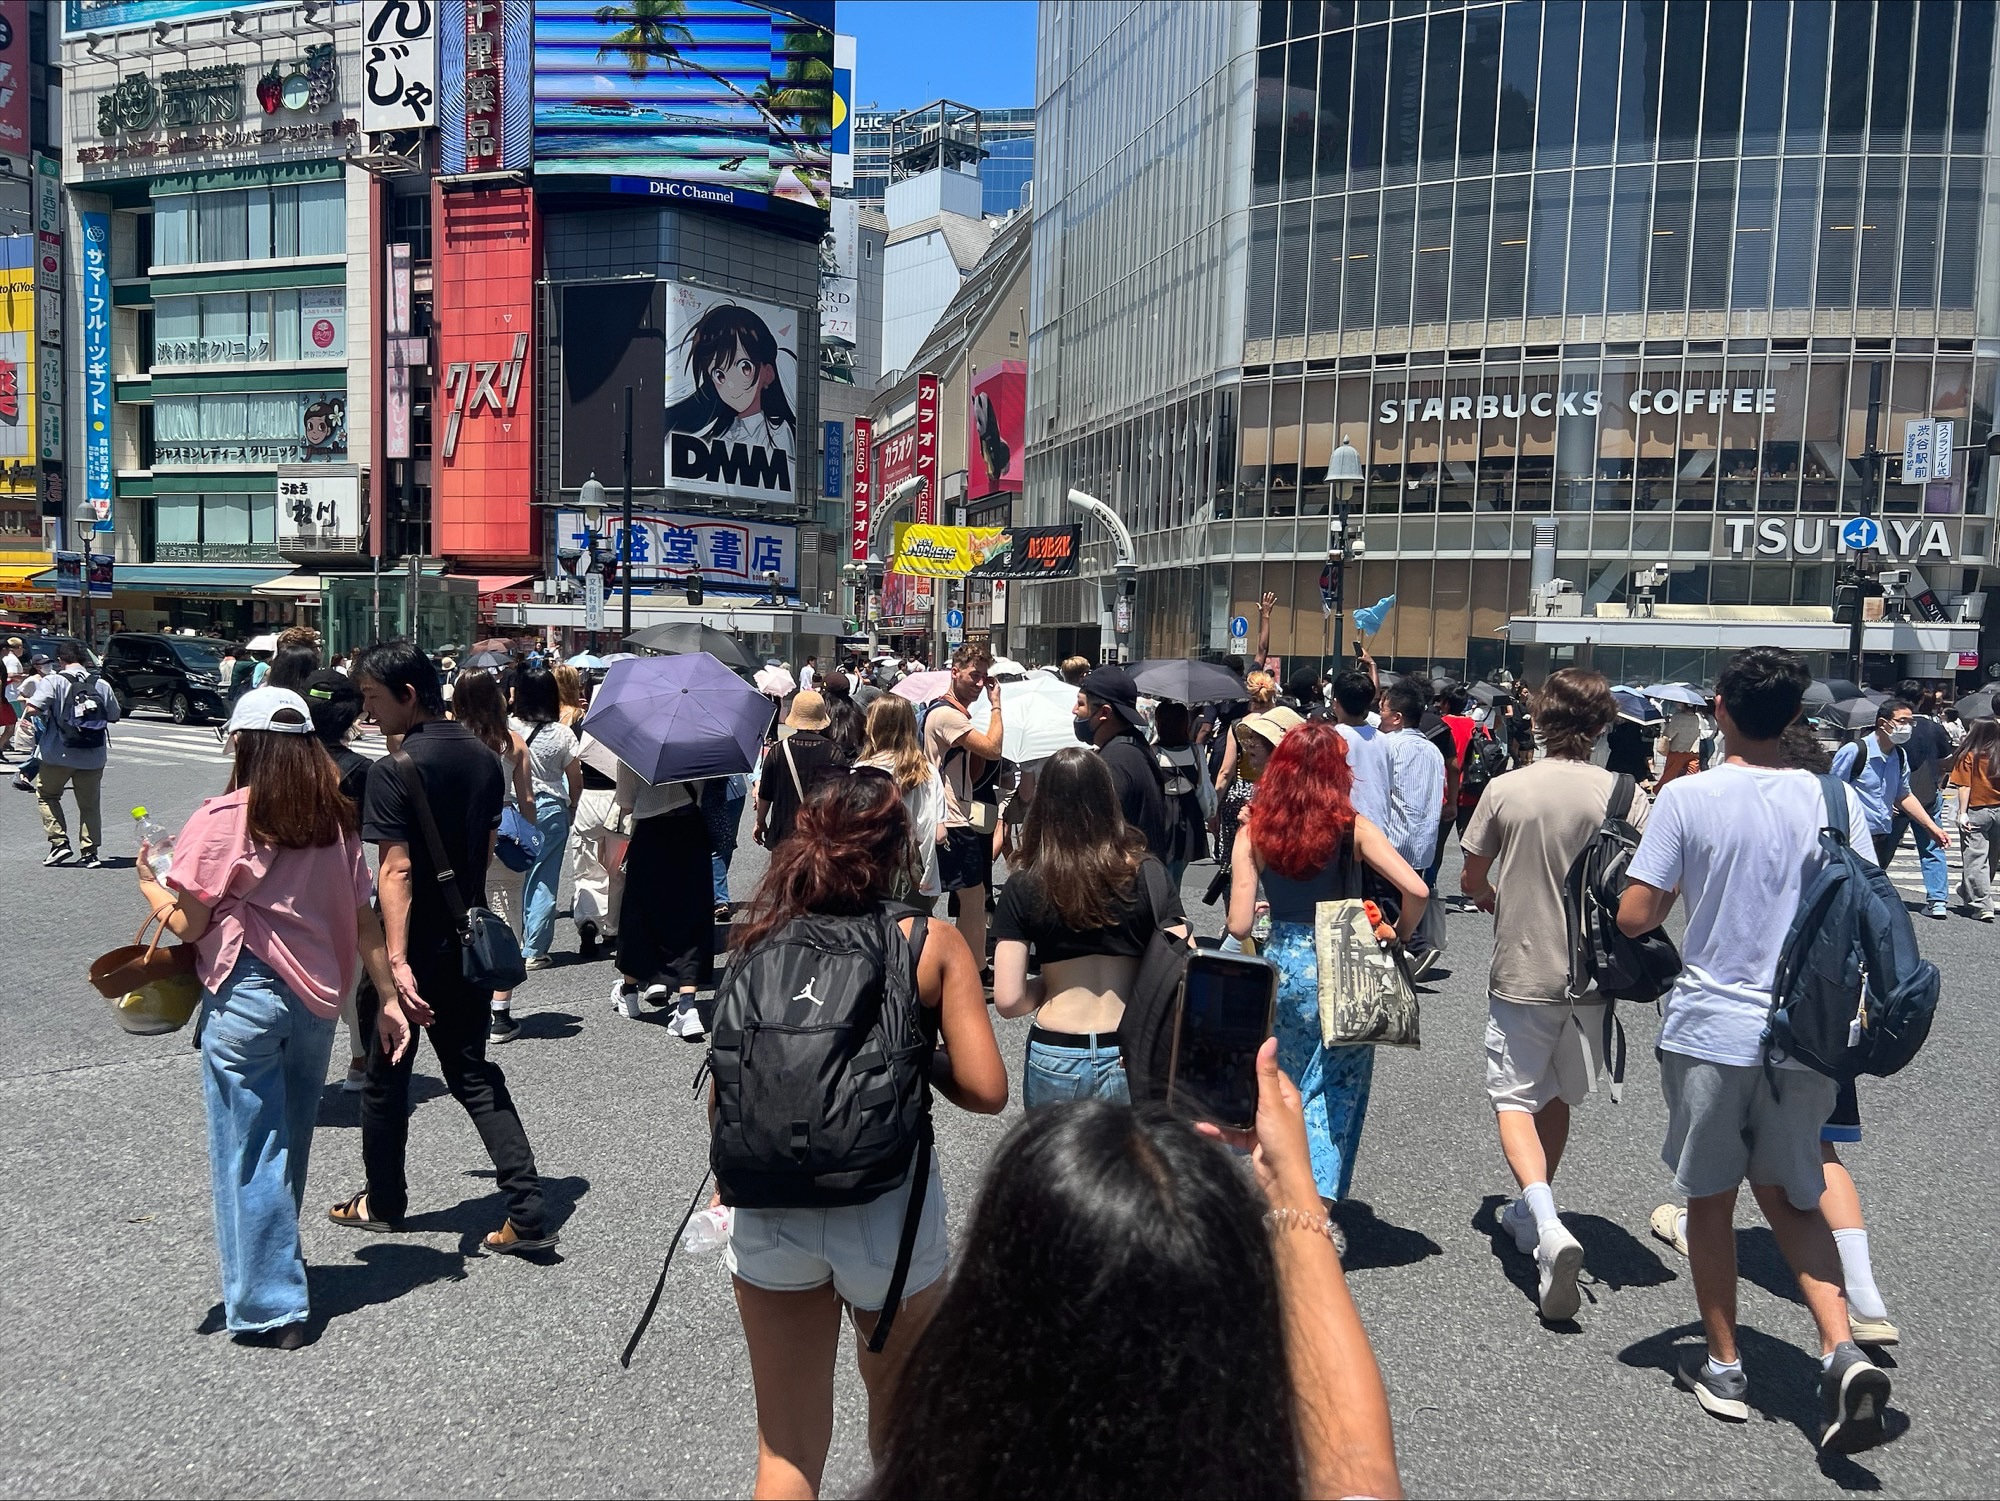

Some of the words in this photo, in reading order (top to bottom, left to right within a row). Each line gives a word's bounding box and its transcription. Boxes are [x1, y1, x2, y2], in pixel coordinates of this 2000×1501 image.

[650, 181, 680, 195] DHC
[682, 185, 733, 203] Channel
[87, 248, 108, 415] サマーフルーツギフト
[829, 319, 848, 332] 7.7
[442, 332, 528, 458] クスリ
[1379, 389, 1603, 424] STARBUCKS
[1629, 387, 1776, 414] COFFEE
[884, 433, 914, 469] カラオケ
[919, 386, 936, 470] カラオケ
[1907, 433, 1915, 459] Shibuya
[1915, 425, 1930, 478] 渋谷駅前
[1937, 425, 1949, 475] スクランブル式
[672, 433, 791, 492] DMM
[853, 481, 868, 551] カラオケ
[589, 577, 597, 622] 文化村通り
